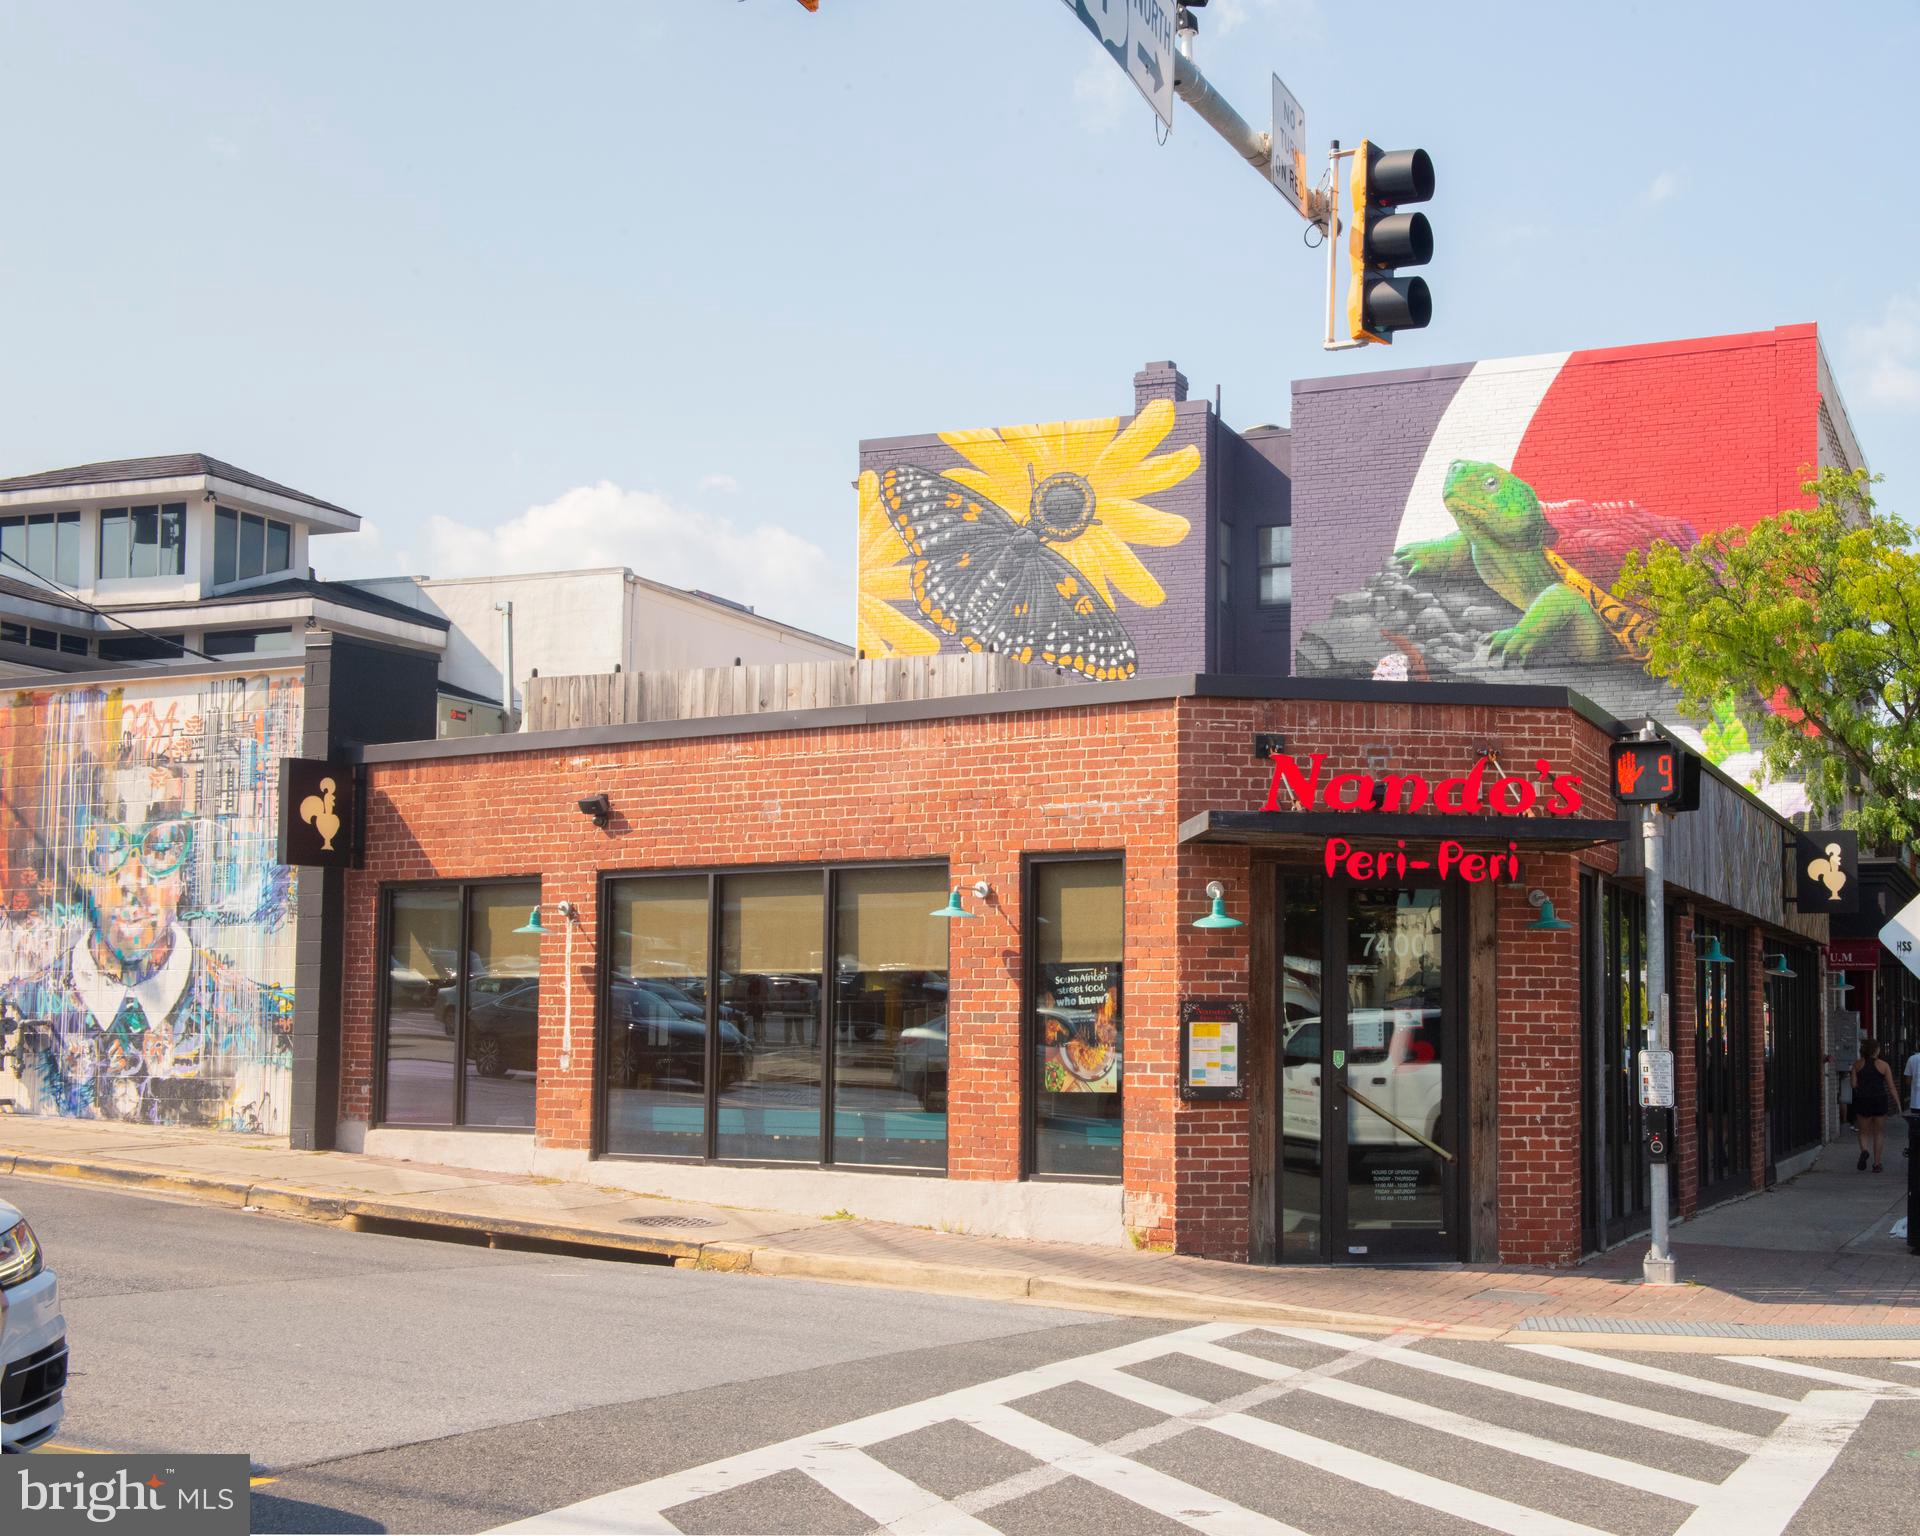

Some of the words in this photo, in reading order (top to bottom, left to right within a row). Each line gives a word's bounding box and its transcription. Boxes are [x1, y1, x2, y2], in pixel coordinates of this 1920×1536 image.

[1283, 101, 1296, 130] NO
[1280, 127, 1300, 169] TURN
[1275, 154, 1287, 183] ON
[1289, 168, 1305, 201] RED
[1259, 752, 1583, 816] Nando's
[1658, 754, 1673, 792] 9
[1324, 837, 1520, 883] Peri-Peri
[1360, 933, 1427, 958] 7400
[1896, 940, 1912, 952] HSS
[1055, 974, 1079, 985] South
[1080, 972, 1107, 982] African
[1057, 985, 1084, 995] street
[1056, 996, 1077, 1007] who
[1078, 993, 1110, 1005] knew?
